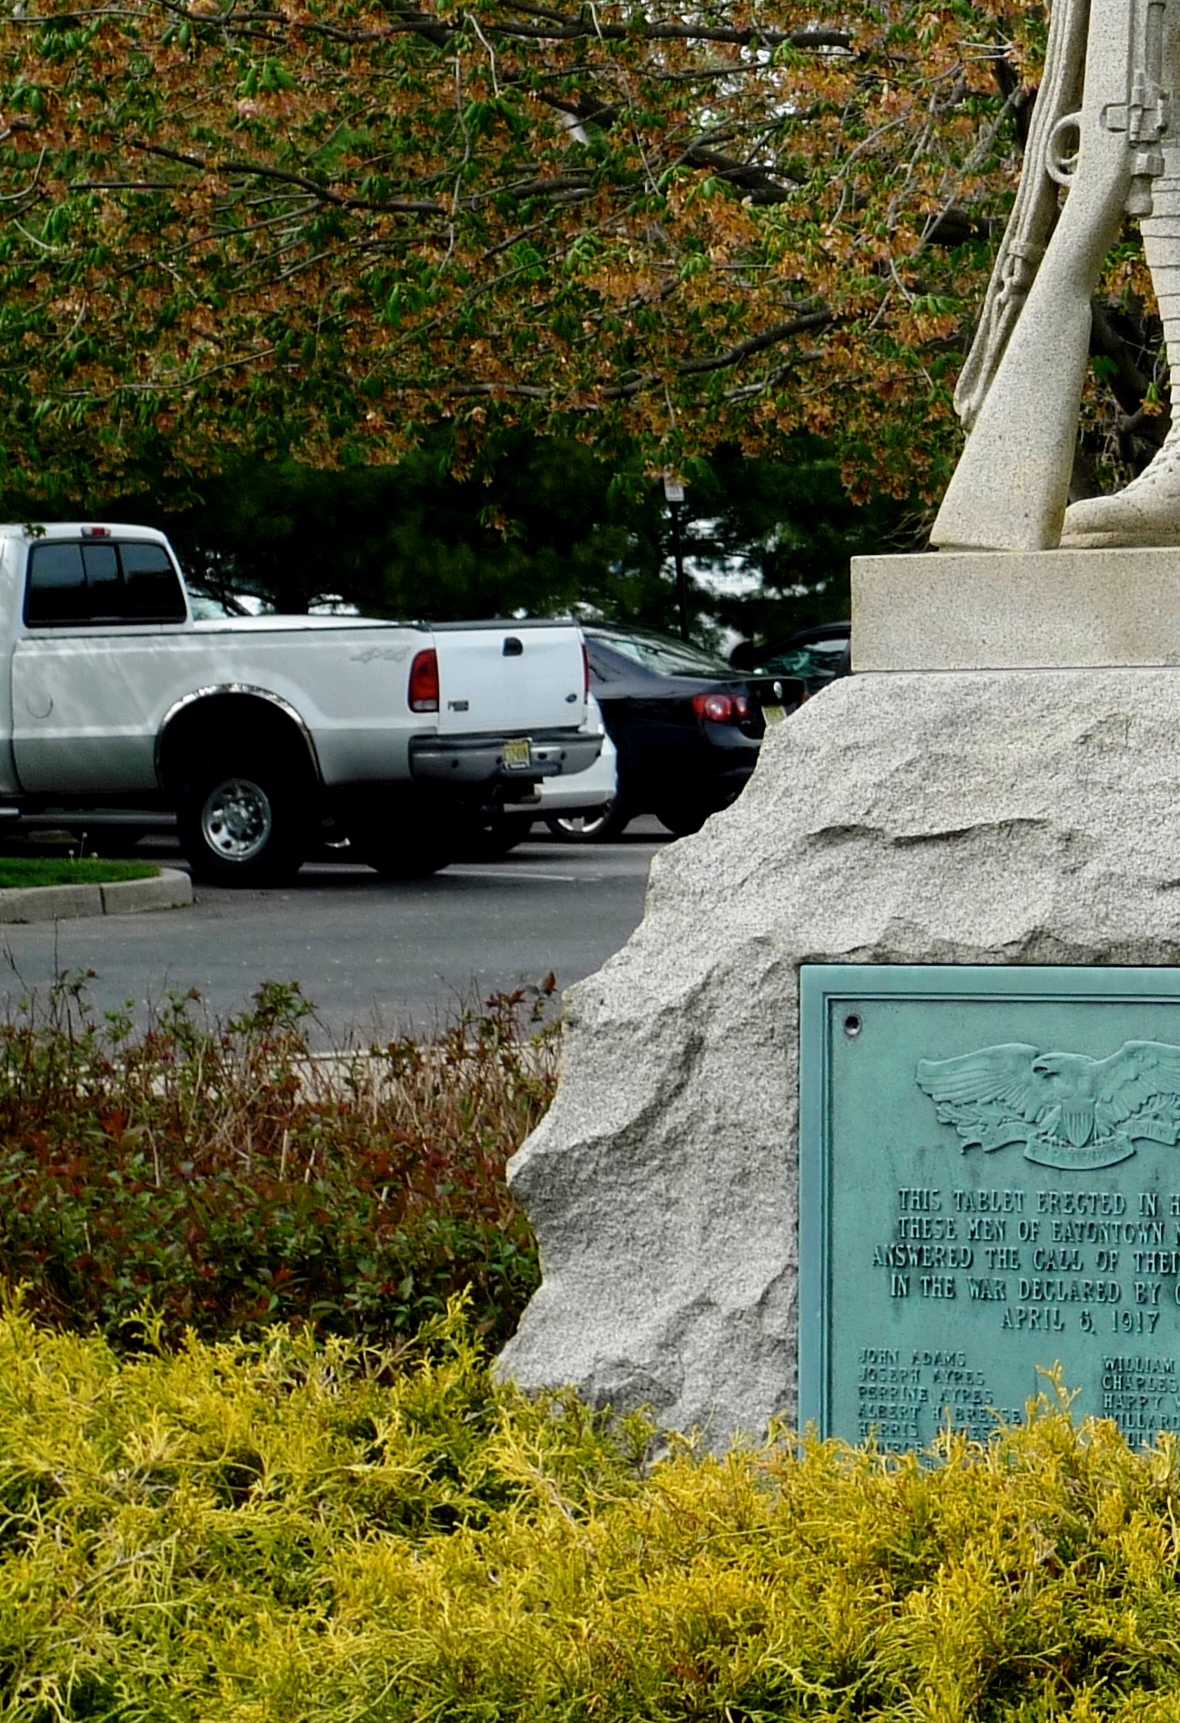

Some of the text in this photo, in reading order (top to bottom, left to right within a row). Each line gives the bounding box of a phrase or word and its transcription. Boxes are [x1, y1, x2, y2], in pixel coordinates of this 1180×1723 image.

[898, 1188, 941, 1211] THIS
[953, 1189, 1025, 1213] TABLET
[1036, 1190, 1127, 1215] ERECTED
[1138, 1193, 1159, 1217] IN
[898, 1217, 957, 1241] THESE
[967, 1218, 1006, 1243] MEN
[1018, 1219, 1040, 1243] OF
[1052, 1220, 1165, 1246] EATONTOWN
[872, 1245, 974, 1269] ANSWERED
[985, 1247, 1021, 1271] THE
[1033, 1248, 1084, 1272] CALL
[1096, 1249, 1120, 1273] OF
[890, 1274, 910, 1298] IN
[920, 1275, 956, 1300] THE
[967, 1276, 1006, 1301] WAR
[1018, 1278, 1121, 1303] DECLARED
[1134, 1281, 1161, 1306] BY
[1001, 1306, 1064, 1332] APRIL
[1112, 1310, 1160, 1334] 1917
[858, 1348, 967, 1367] JOHN ADAMS
[1102, 1355, 1176, 1375] WILLIAM
[858, 1366, 921, 1384] JOSEPH
[1102, 1375, 1179, 1394] CHARLES
[858, 1403, 922, 1420] ALBERT
[1103, 1393, 1163, 1412] HARRY
[858, 1421, 919, 1438] HRRIS
